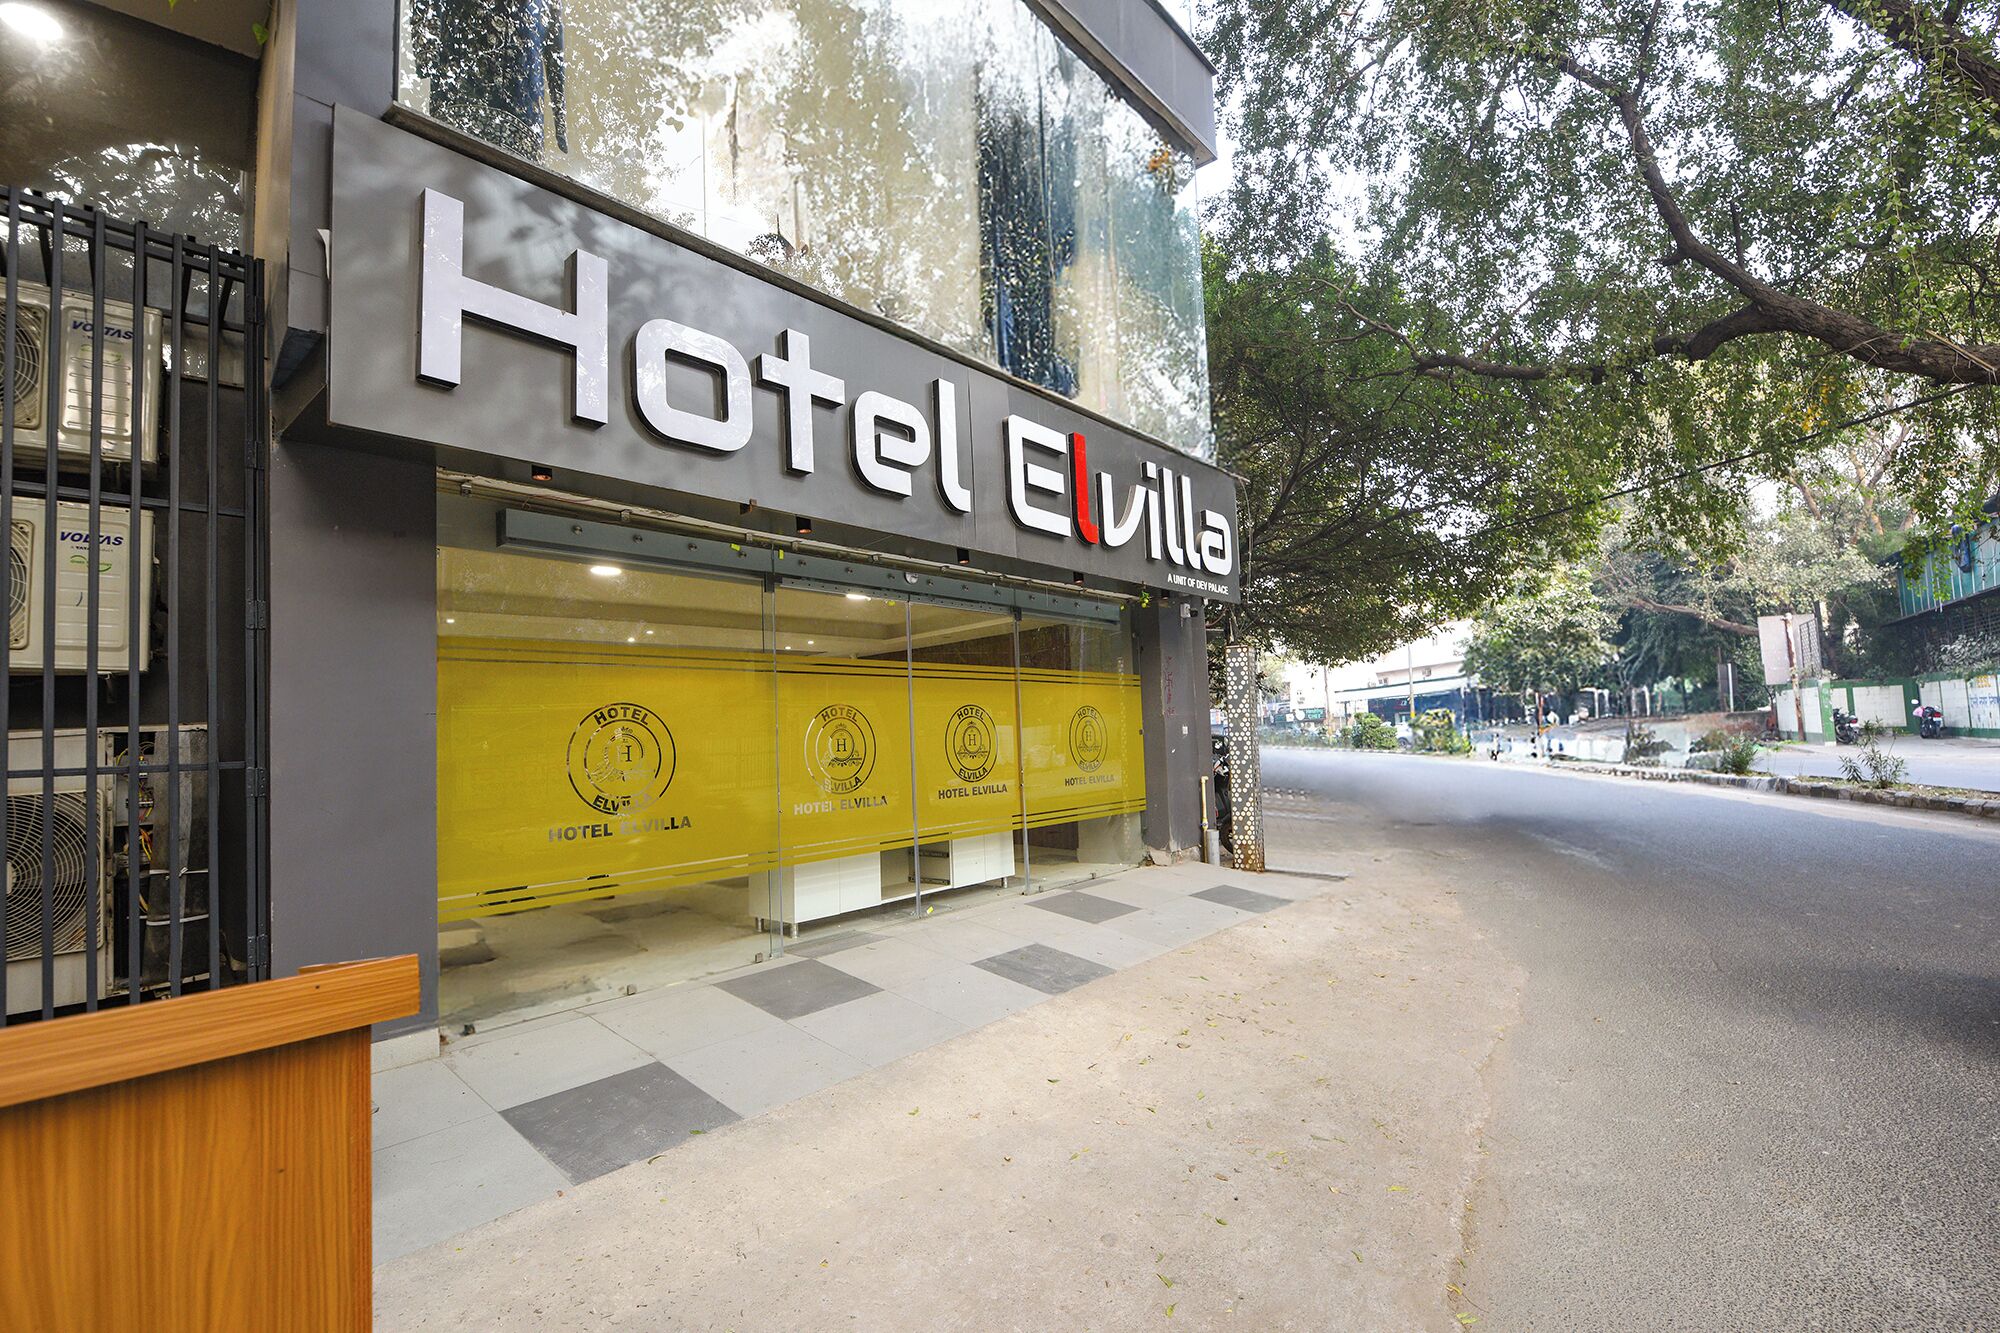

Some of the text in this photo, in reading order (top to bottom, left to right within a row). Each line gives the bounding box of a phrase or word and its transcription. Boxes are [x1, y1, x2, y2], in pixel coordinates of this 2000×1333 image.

[72, 320, 134, 339] VOTAS
[416, 187, 1233, 576] Hotel Elvilla
[1167, 573, 1229, 595] A UNIT OF DEV PALACE
[593, 707, 649, 725] HOTEL
[822, 708, 858, 722] HOTEL
[956, 707, 984, 720] HOTEL
[1077, 708, 1098, 719] HOTEL
[836, 738, 847, 752] H
[968, 734, 977, 746] H
[958, 767, 988, 780] ELVILLA
[823, 776, 862, 793] ELVILLA
[1065, 777, 1087, 787] HOTEL
[938, 784, 1008, 800] HOTEL ELVILLA
[793, 795, 888, 815] HOTEL ELVILLA
[548, 823, 613, 842] HOTEL
